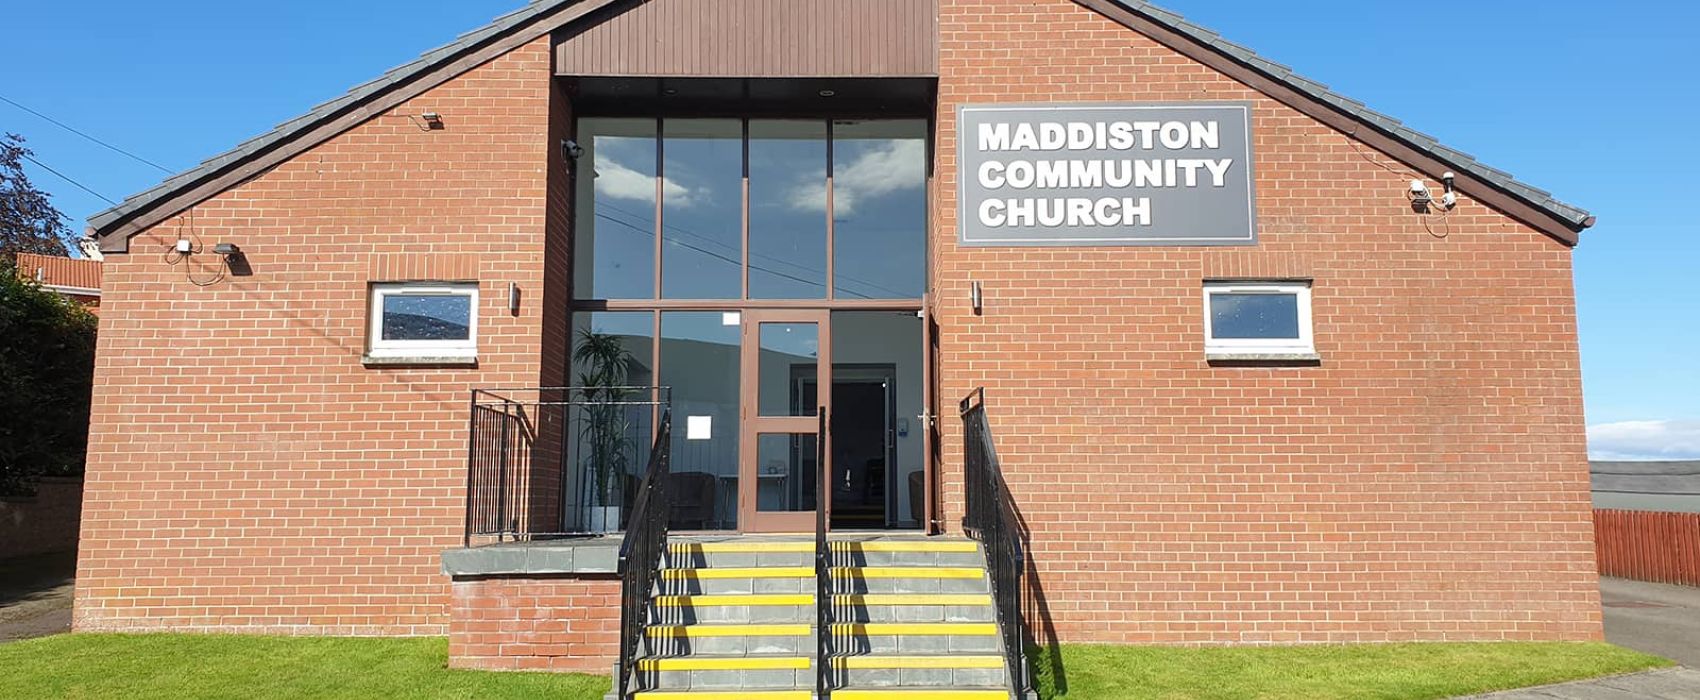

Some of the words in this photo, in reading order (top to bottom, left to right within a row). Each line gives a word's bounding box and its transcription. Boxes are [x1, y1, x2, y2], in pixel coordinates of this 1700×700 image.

[978, 121, 1219, 151] MADDISTON
[978, 158, 1233, 189] COMMUNITY
[978, 197, 1152, 227] CHURCH
